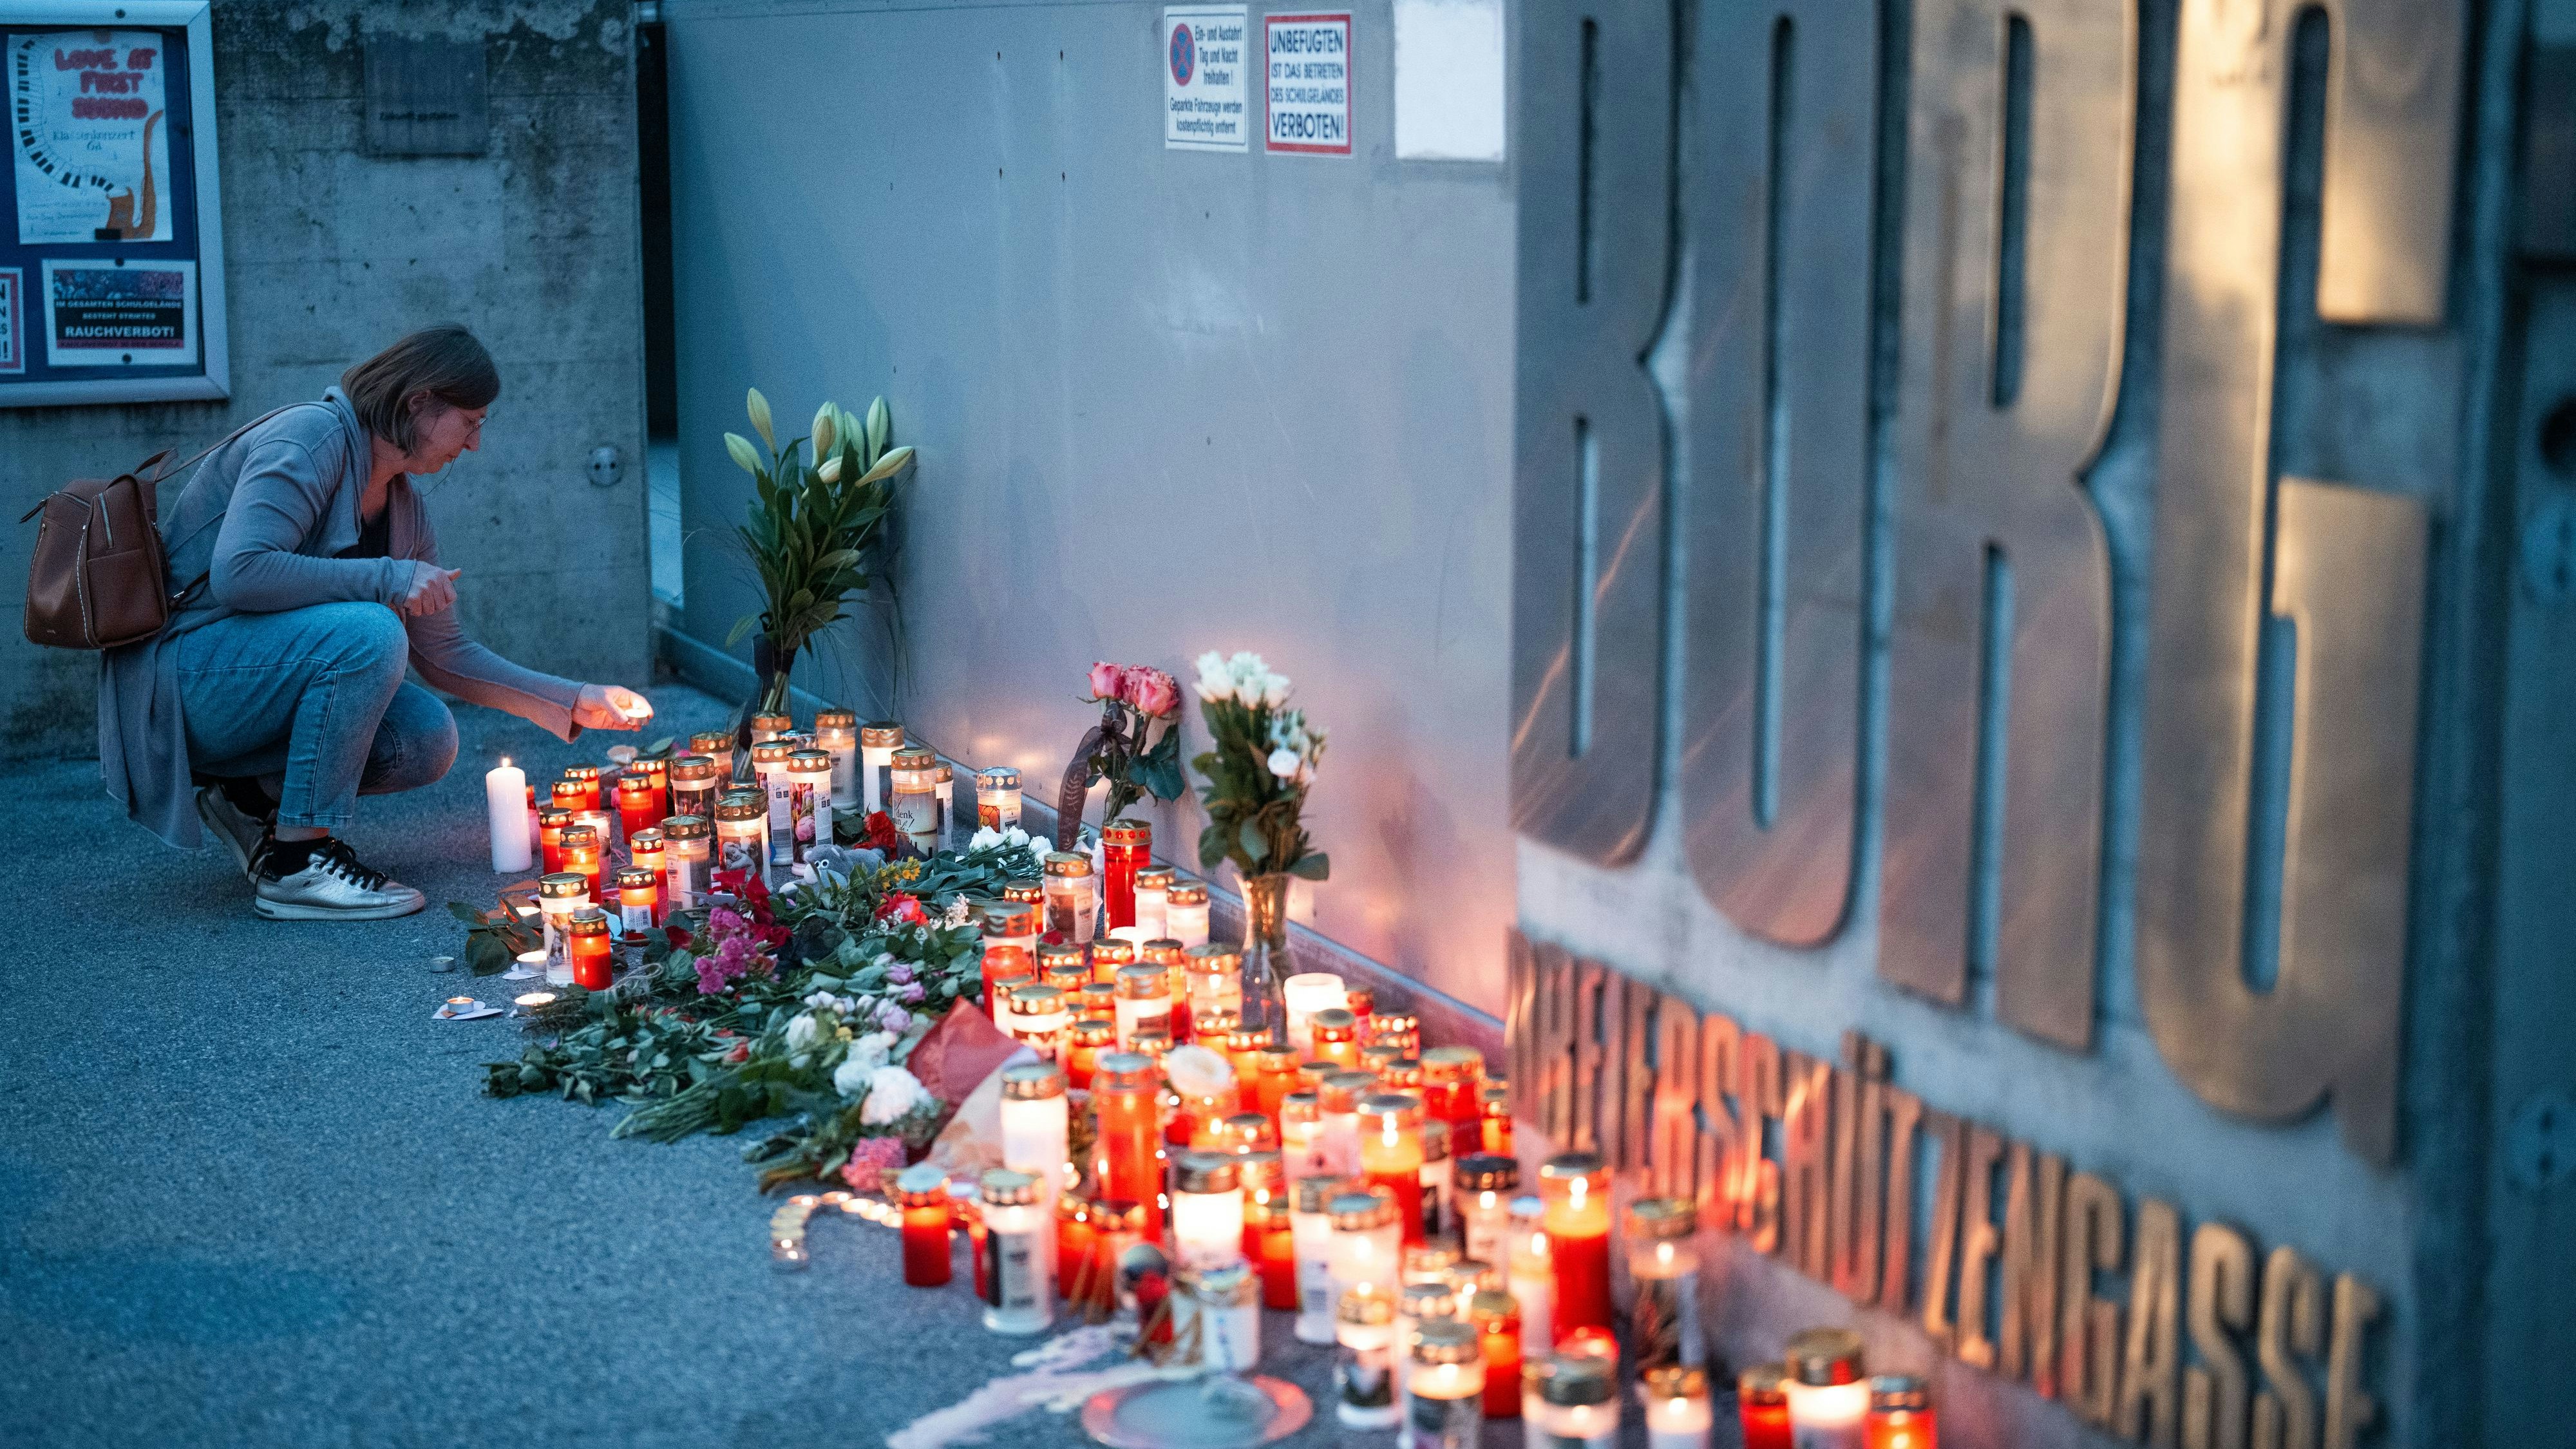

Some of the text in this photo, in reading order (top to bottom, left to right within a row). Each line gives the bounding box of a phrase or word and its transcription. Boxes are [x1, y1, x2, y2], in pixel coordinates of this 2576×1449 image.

[1195, 25, 1242, 41] Ein- und Ausfahrt
[1271, 30, 1343, 53] UNBEFUGTEN
[54, 48, 118, 71] LOVE
[1199, 48, 1238, 66] Tag und Nacht
[1203, 70, 1229, 86] freihalten
[1271, 62, 1343, 79] IST DAS BETRETEN
[80, 71, 144, 93] FIRST
[1271, 87, 1283, 102] DES
[1170, 97, 1242, 116] Geparkte Fahrzeuge werden
[1176, 118, 1236, 137] kostenpflichtig entfernt
[1272, 113, 1344, 140] VERBOTEN!
[65, 325, 175, 338] RAUCHVERBOT!
[1507, 0, 2467, 1169] BORG
[896, 809, 913, 819] denk
